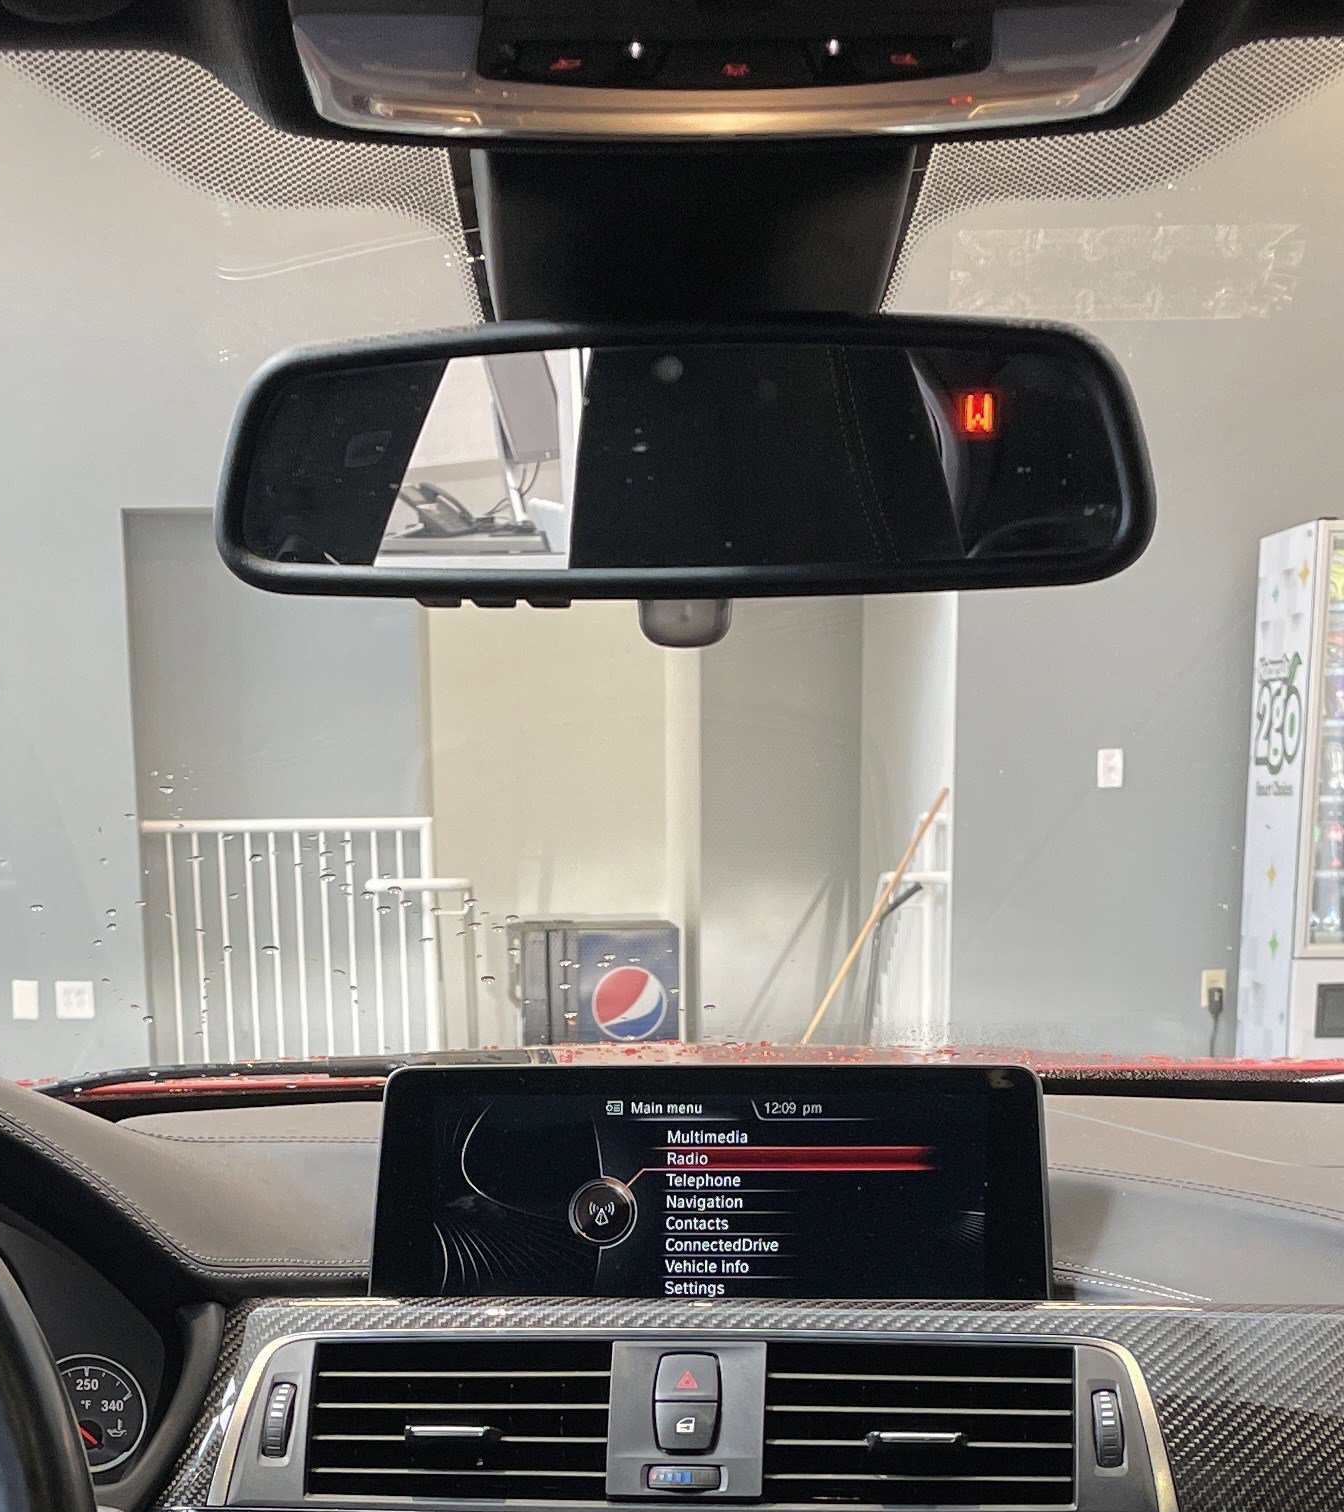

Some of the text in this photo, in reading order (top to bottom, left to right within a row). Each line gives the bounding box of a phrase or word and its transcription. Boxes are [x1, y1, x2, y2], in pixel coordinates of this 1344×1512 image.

[631, 1102, 702, 1115] Main menu
[763, 1102, 823, 1117] 12:09 pm
[667, 1130, 748, 1144] Multimedia
[666, 1151, 709, 1166] Radio
[666, 1173, 742, 1190] Telephone
[666, 1194, 744, 1212] Navigation
[665, 1216, 729, 1231] Contacts
[665, 1237, 779, 1253] ConnectedDrive
[665, 1259, 717, 1275] Vehicle
[664, 1281, 725, 1298] Settings
[75, 1378, 99, 1392] 250
[101, 1399, 124, 1413] 340
